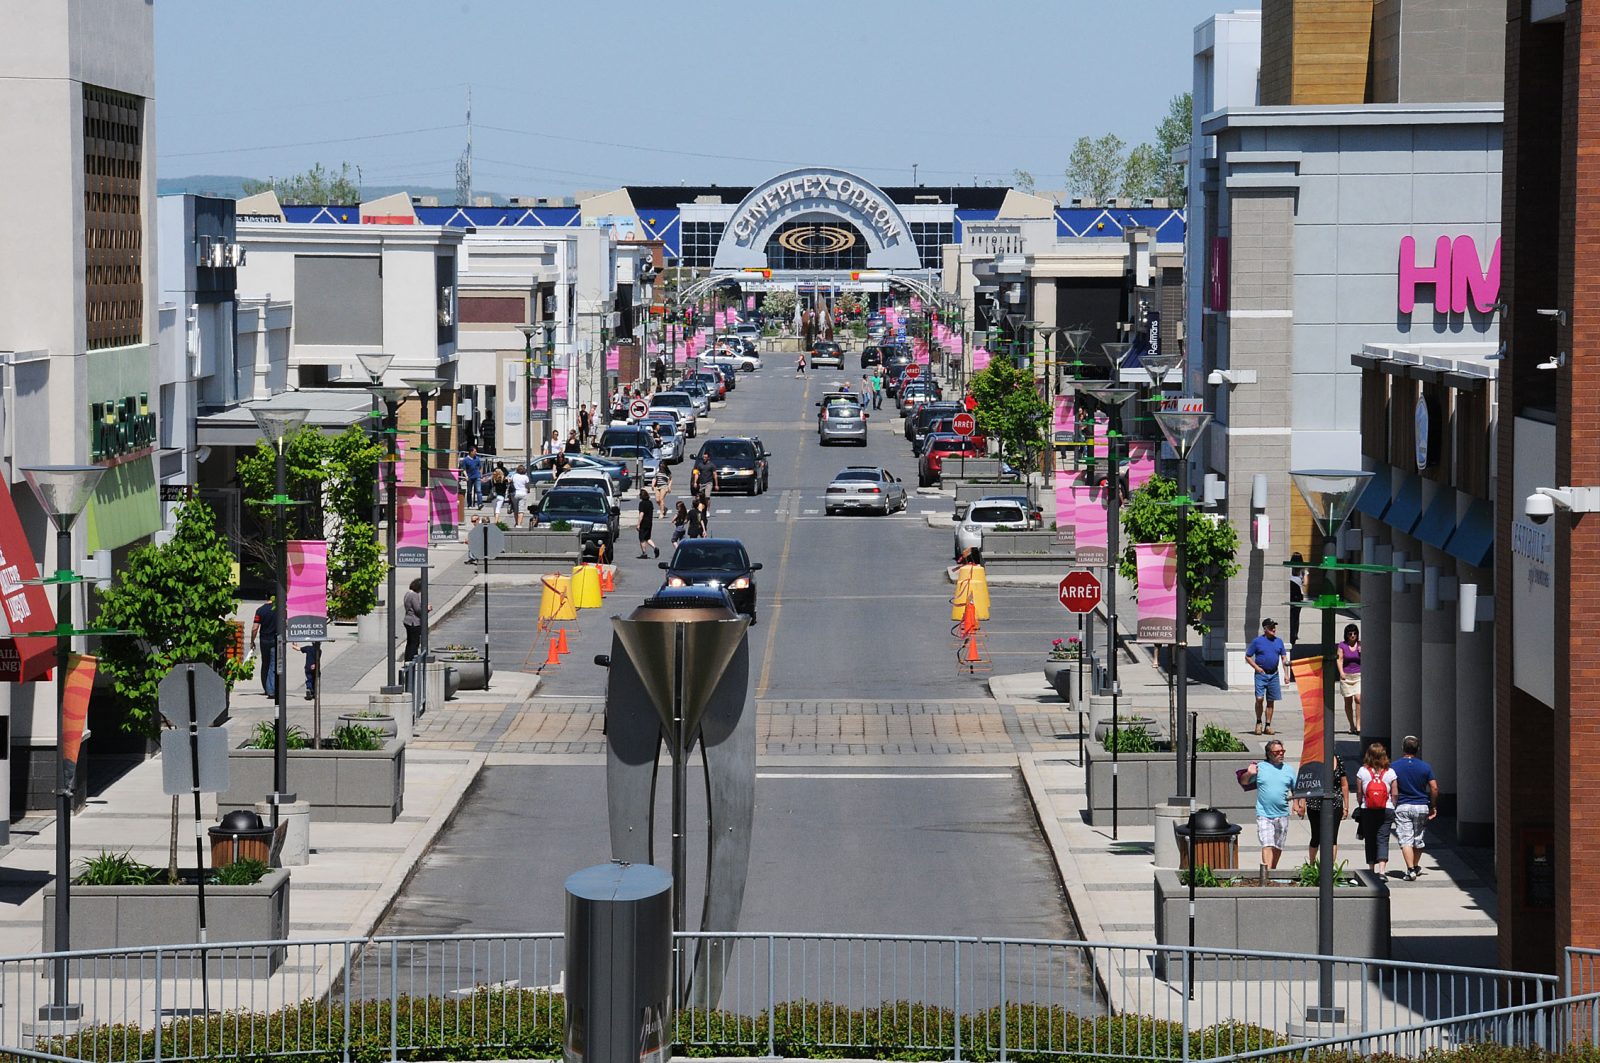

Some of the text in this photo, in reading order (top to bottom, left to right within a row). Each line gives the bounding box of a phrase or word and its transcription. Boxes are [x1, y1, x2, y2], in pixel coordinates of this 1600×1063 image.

[734, 175, 901, 240] CINEPLEX ODEON
[1148, 320, 1158, 355] Reitmans
[954, 420, 974, 429] ARRÊT
[1061, 584, 1100, 599] ARRÊT
[1297, 780, 1321, 789] EXTASIA
